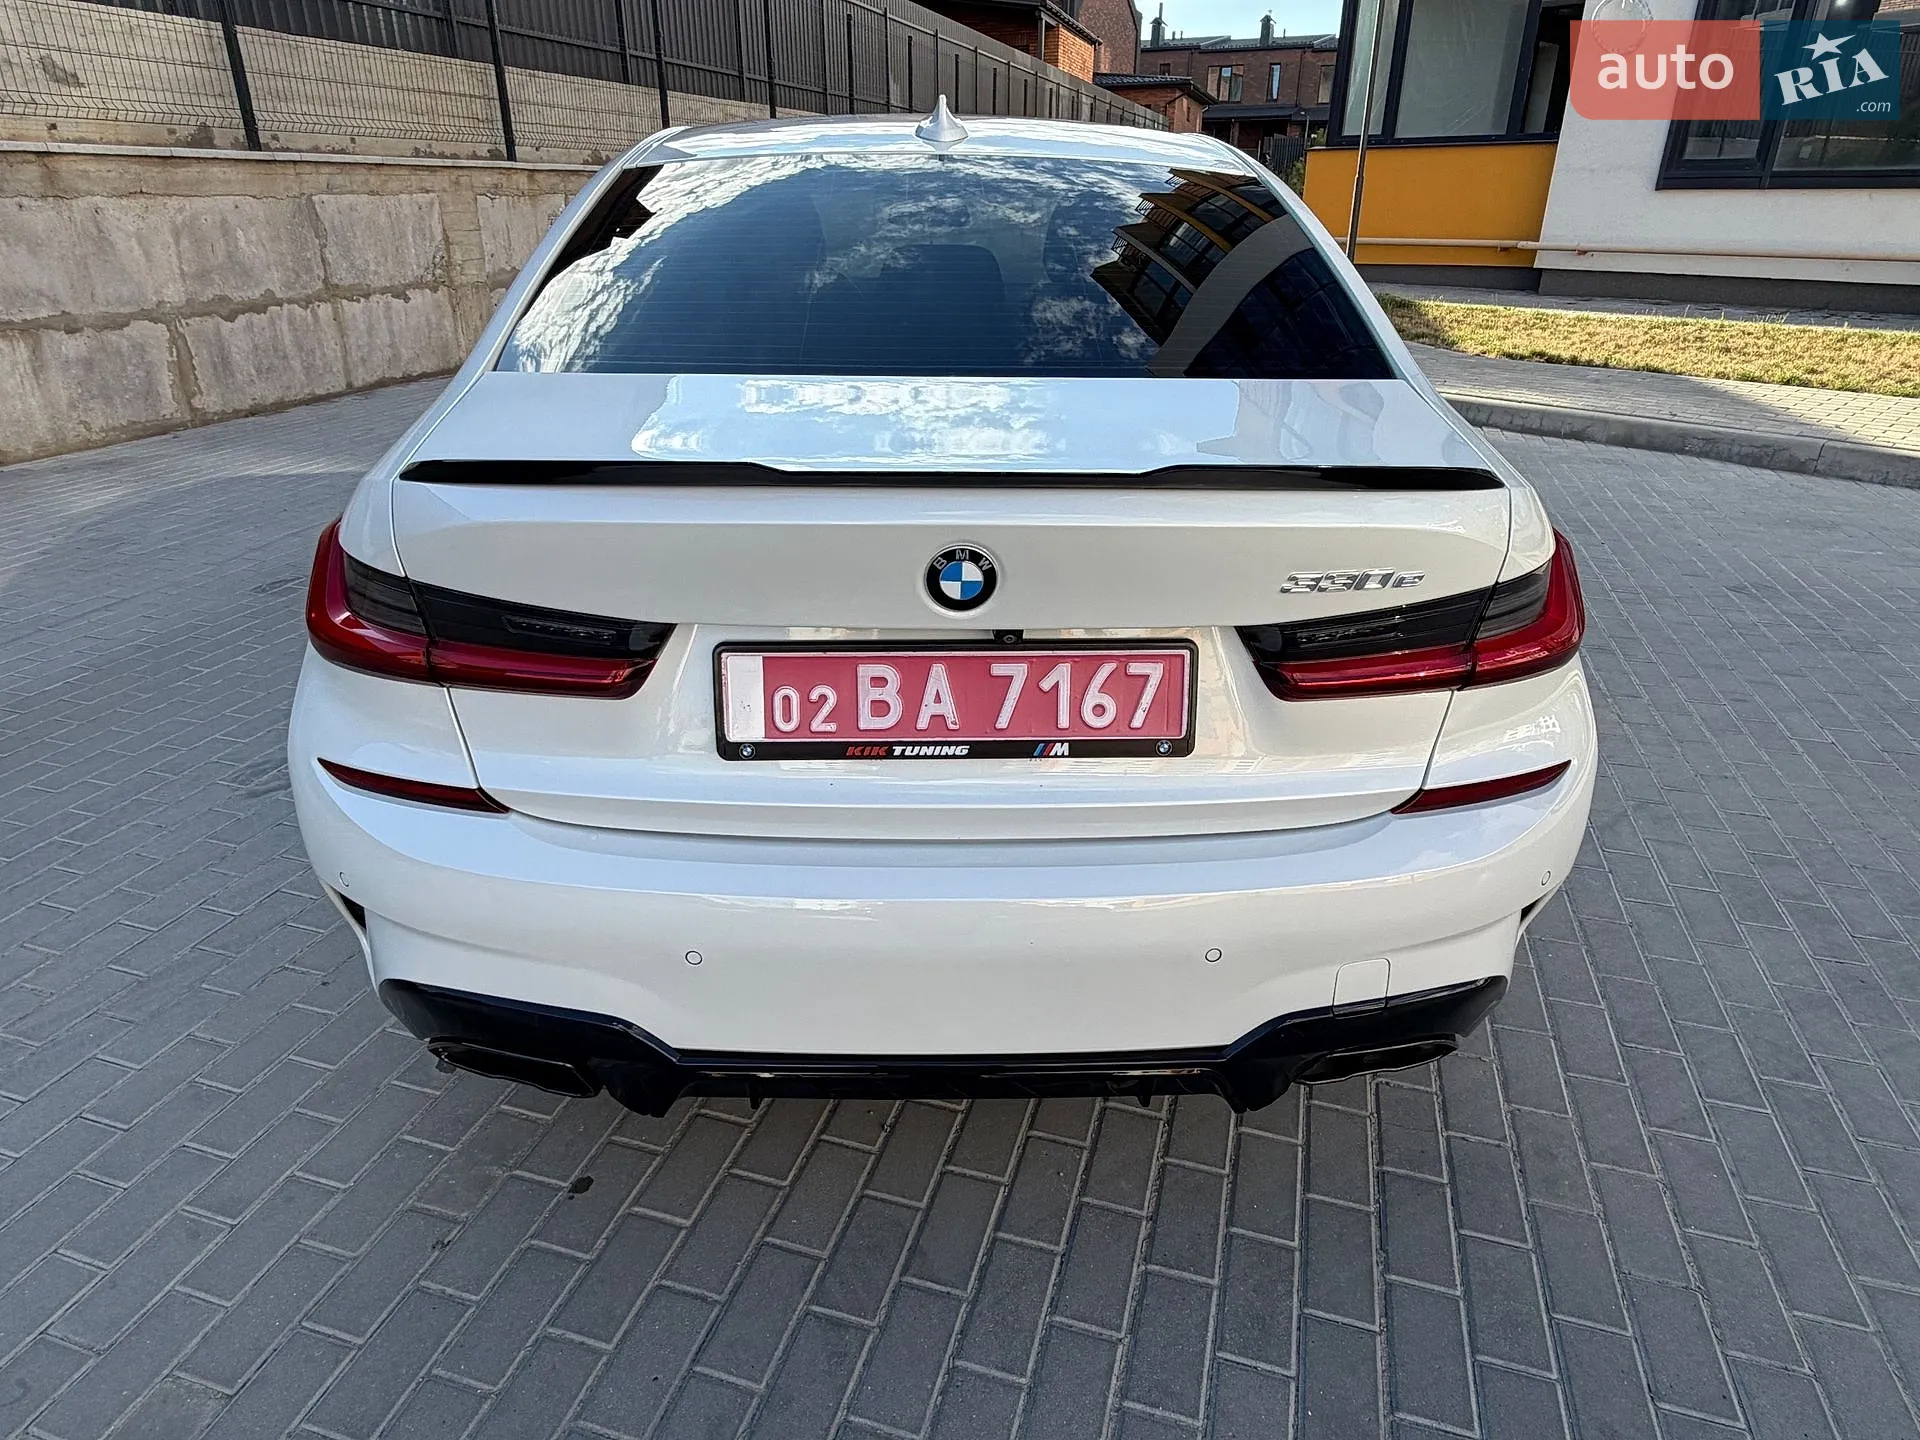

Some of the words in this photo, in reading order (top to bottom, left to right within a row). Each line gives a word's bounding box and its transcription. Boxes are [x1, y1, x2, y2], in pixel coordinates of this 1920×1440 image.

[933, 549, 993, 571] BMW
[1280, 568, 1426, 593] 330e
[772, 685, 837, 733] 02
[857, 663, 960, 731] BA
[989, 662, 1165, 730] 7167
[846, 746, 888, 757] KIK
[892, 745, 970, 757] TUNING
